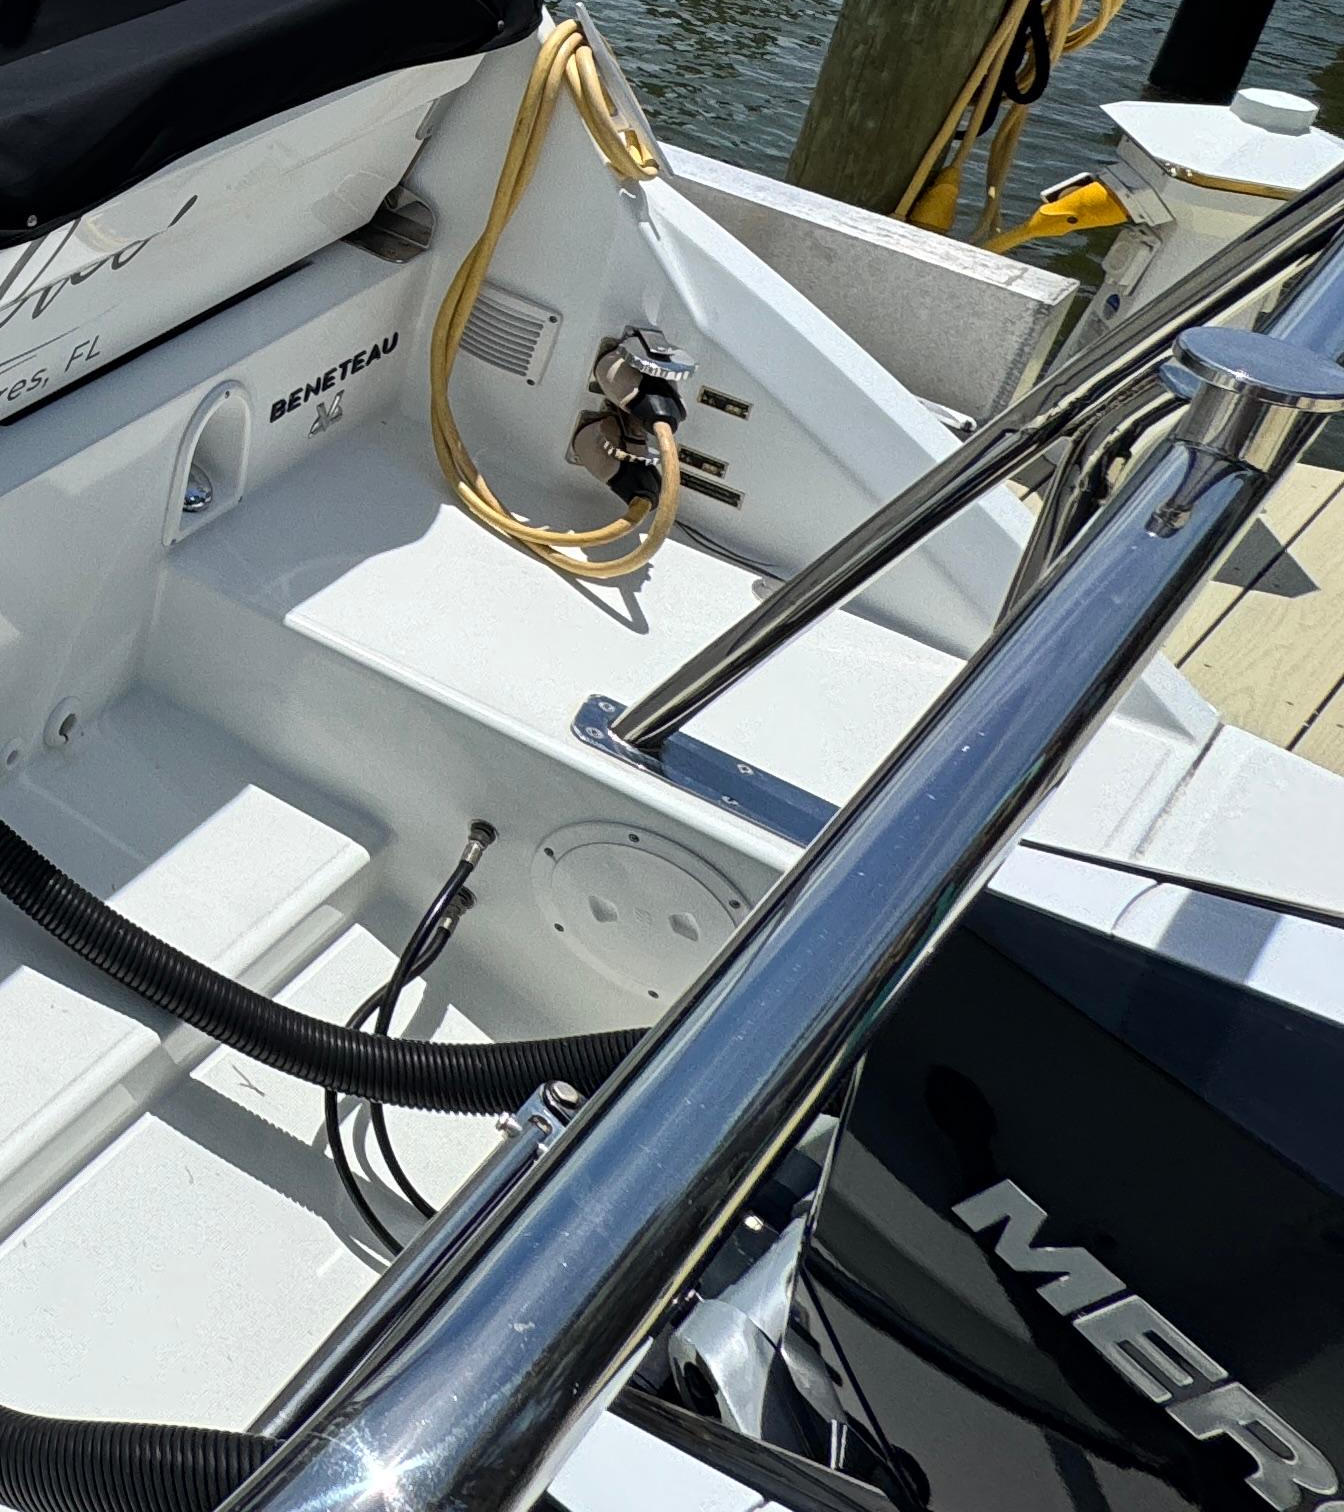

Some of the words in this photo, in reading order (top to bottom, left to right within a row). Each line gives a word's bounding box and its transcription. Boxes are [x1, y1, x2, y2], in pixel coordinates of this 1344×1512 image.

[64, 335, 101, 373] FL
[269, 331, 399, 424] BENETEAU
[951, 1178, 1344, 1512] MER
